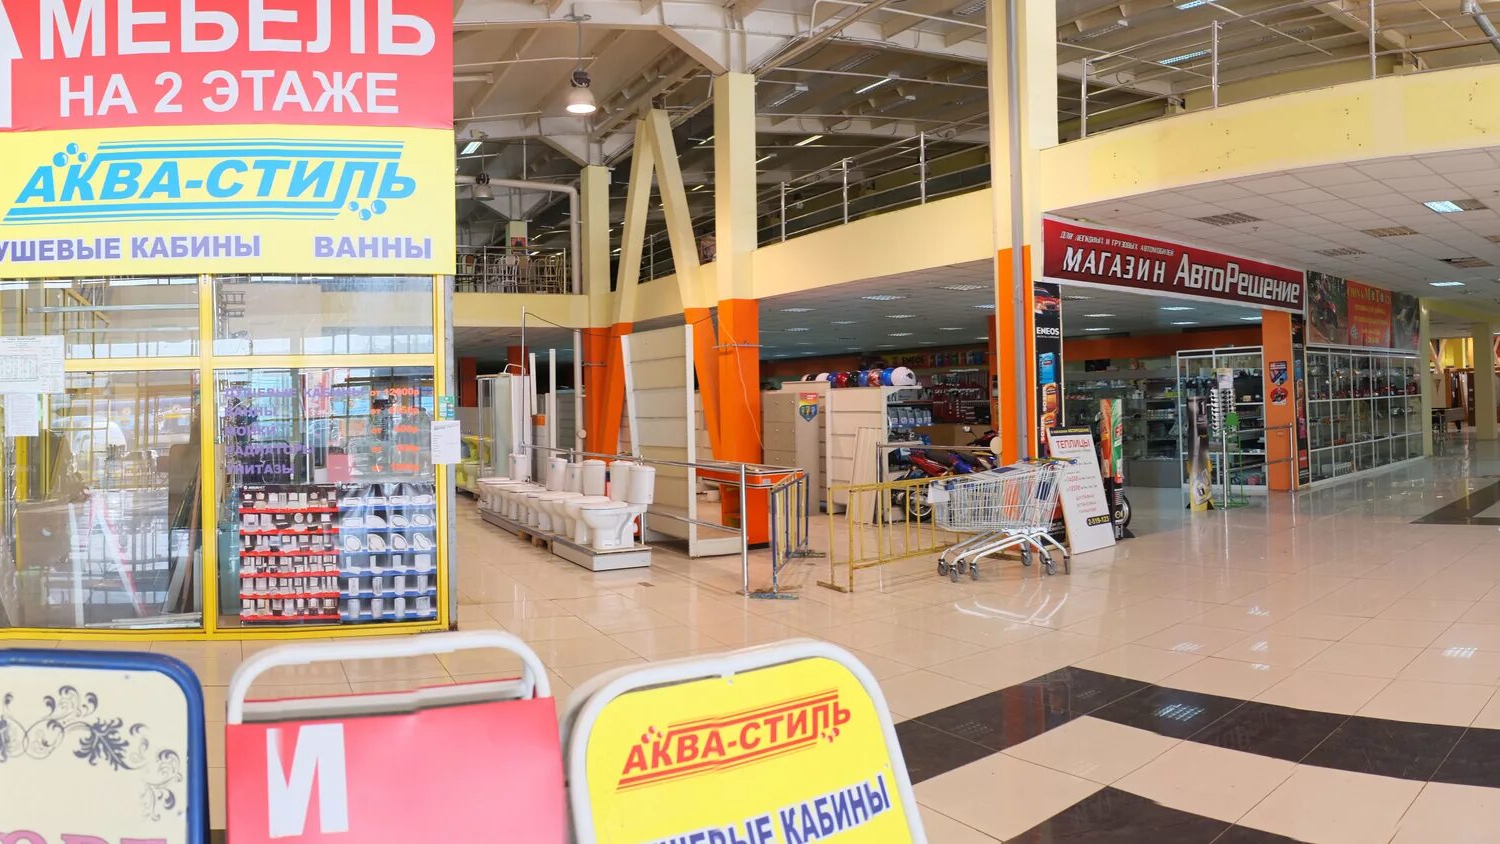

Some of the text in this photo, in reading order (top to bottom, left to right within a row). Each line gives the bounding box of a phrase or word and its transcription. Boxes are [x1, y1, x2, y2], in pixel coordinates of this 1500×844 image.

[39, 0, 436, 60] МЕБЕЛЬ
[59, 69, 399, 118] НА 2 ЭТАЖЕ
[14, 157, 417, 205] АКВА-СТИЛЬ
[131, 235, 261, 260] КАБИНЫ
[314, 236, 432, 260] ВАННЫ
[1062, 246, 1300, 304] МАГАЗИН АвтоРешение
[1036, 327, 1060, 335] ENEOS
[622, 700, 851, 775] АКВА-СТИЛЬ
[779, 774, 891, 844] КАБИНЫ
